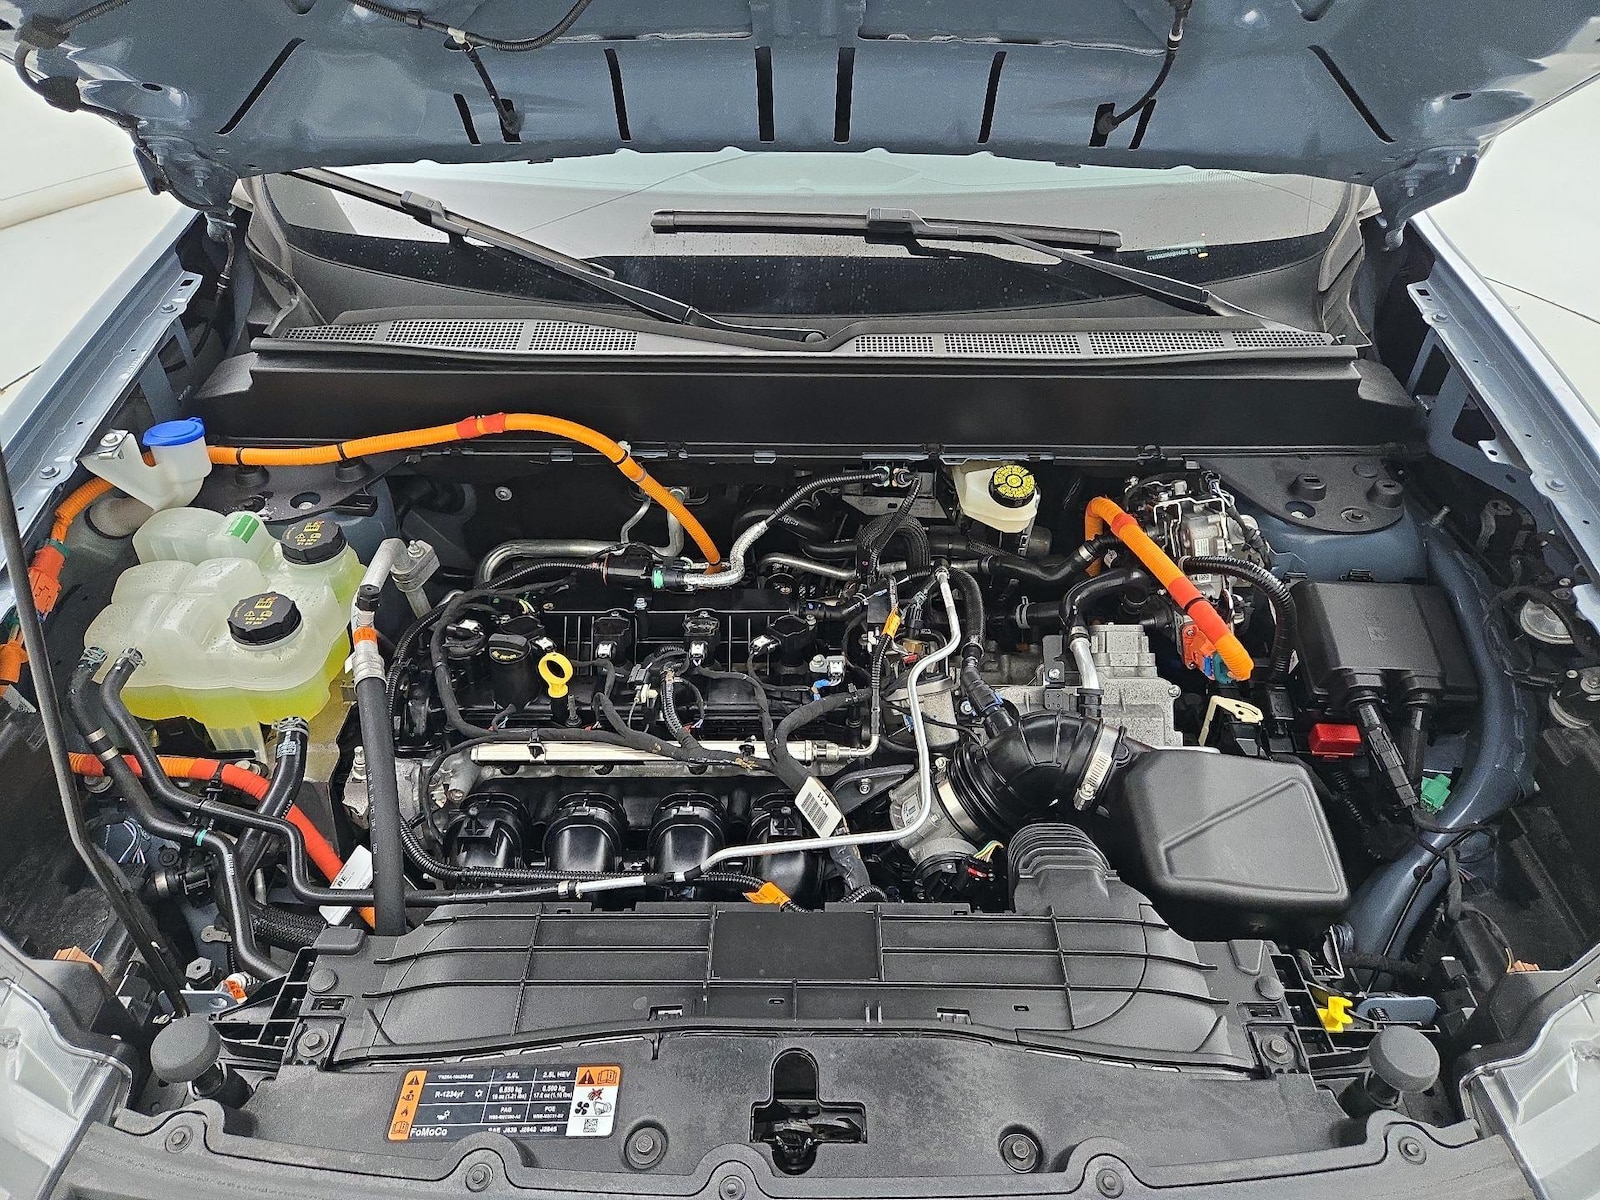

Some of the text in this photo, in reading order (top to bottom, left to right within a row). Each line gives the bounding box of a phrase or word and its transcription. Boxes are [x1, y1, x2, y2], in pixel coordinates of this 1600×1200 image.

[542, 1070, 571, 1079] 2.5L HEV
[515, 1086, 523, 1094] kg
[558, 1085, 566, 1093] kg
[434, 1090, 465, 1099] R-1234yf
[410, 1127, 448, 1137] FoMoCo
